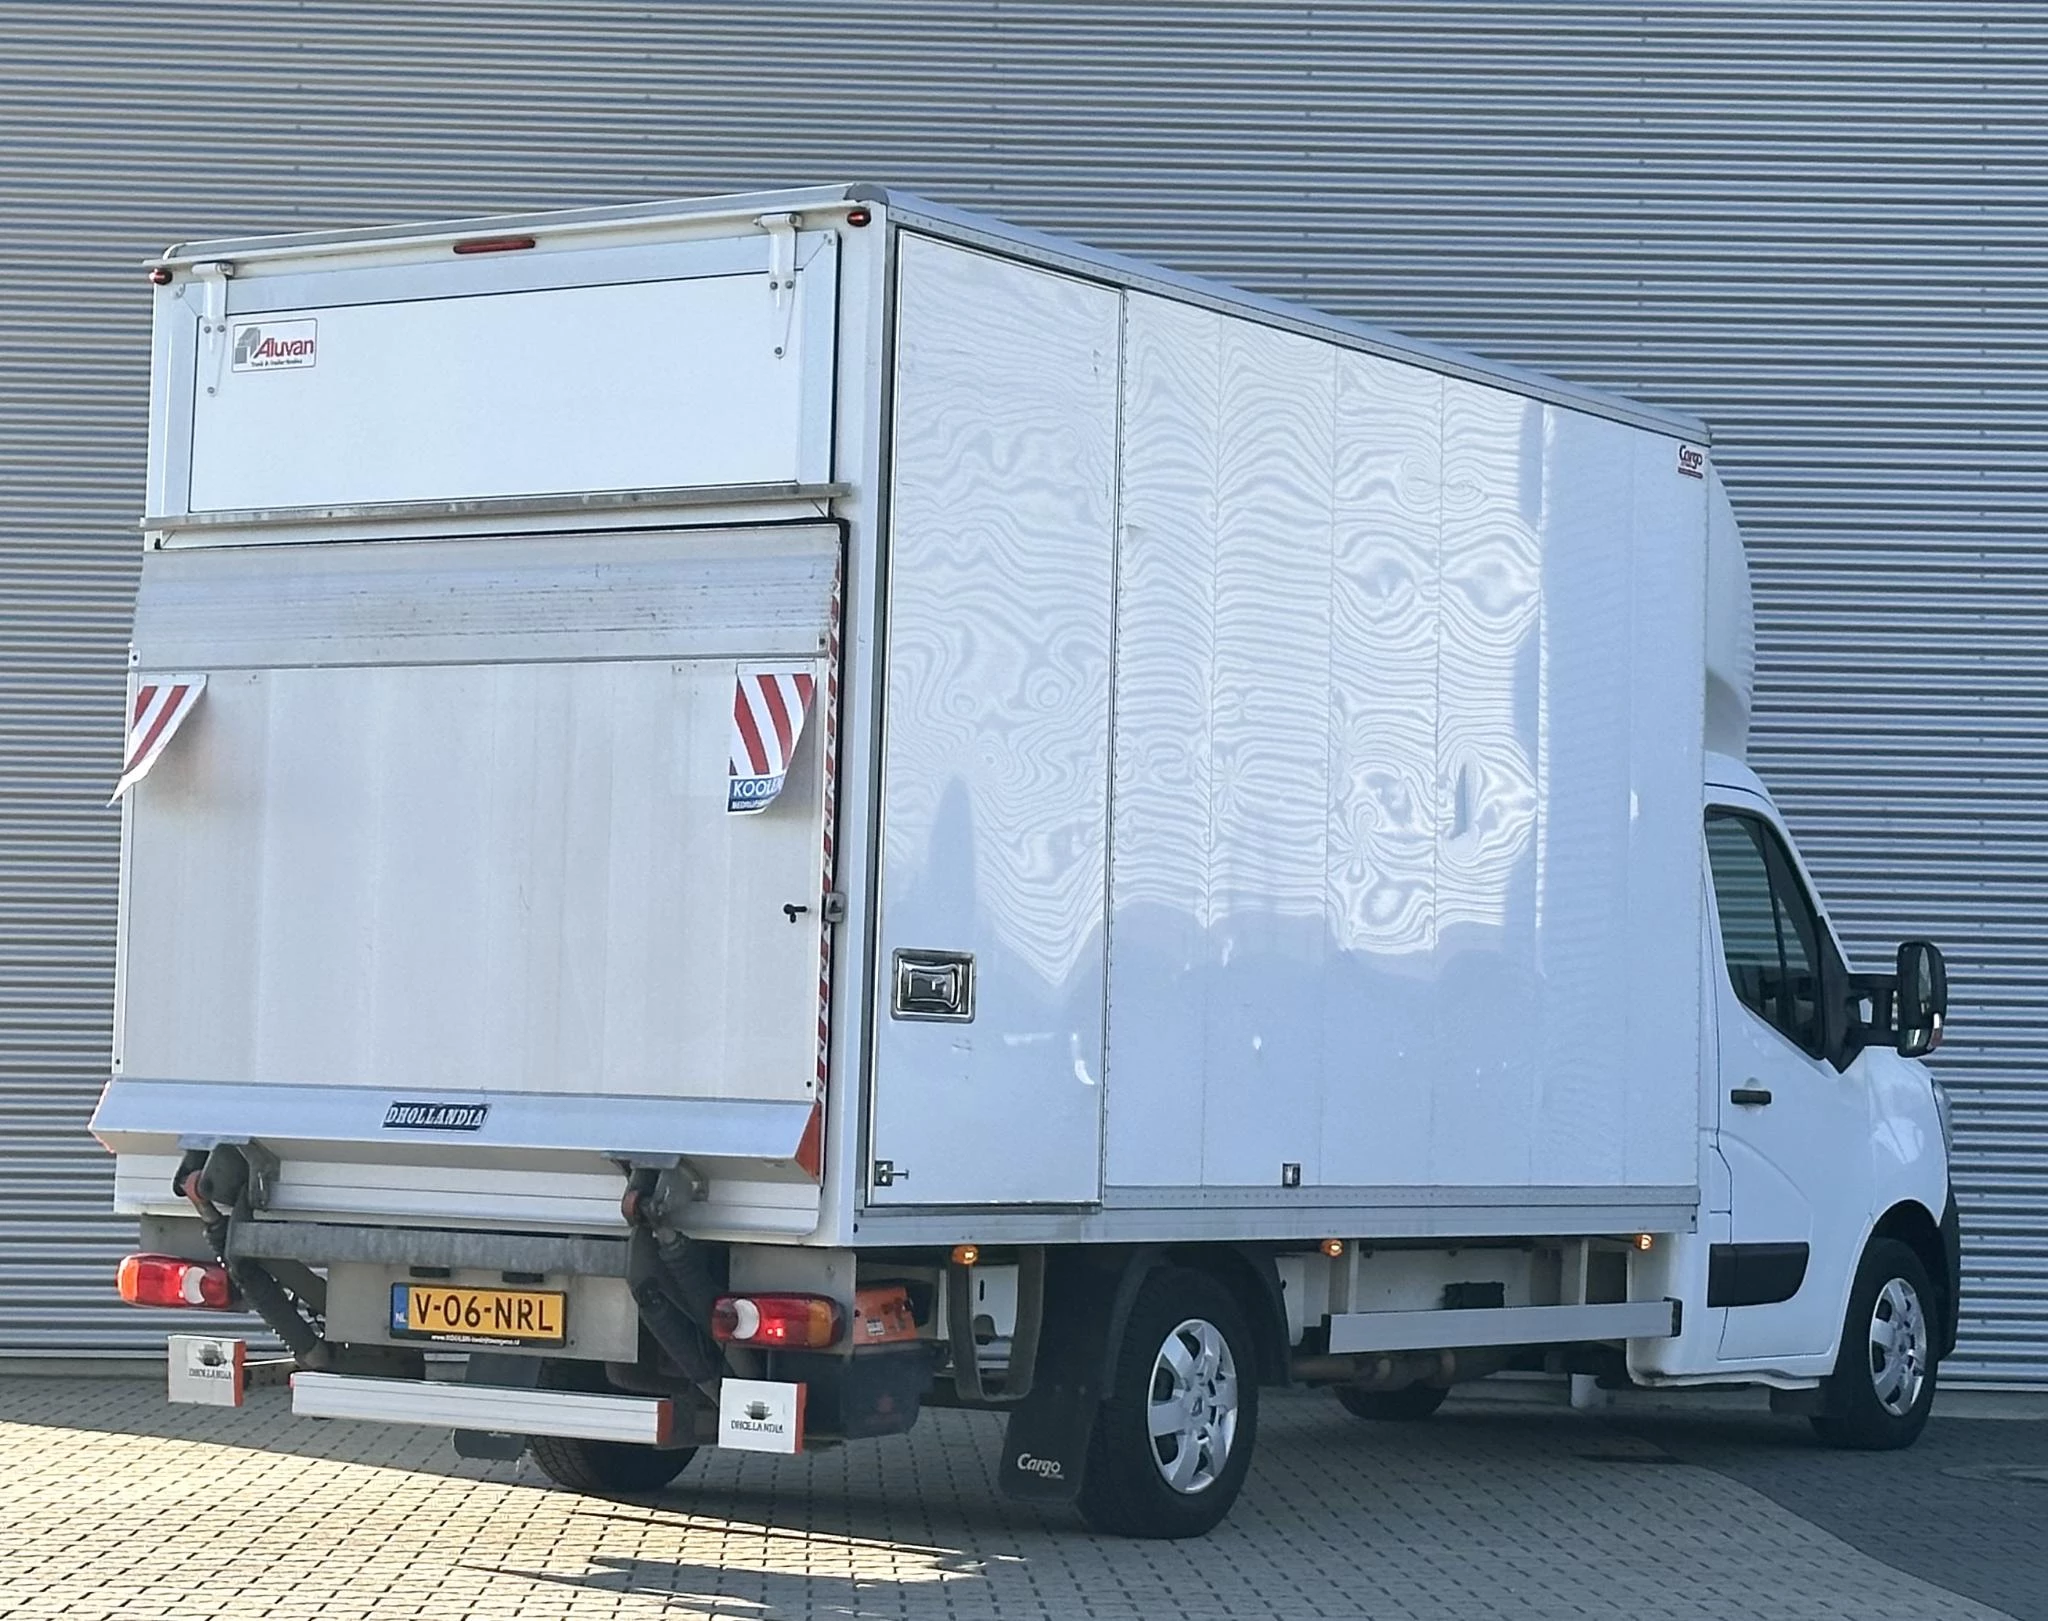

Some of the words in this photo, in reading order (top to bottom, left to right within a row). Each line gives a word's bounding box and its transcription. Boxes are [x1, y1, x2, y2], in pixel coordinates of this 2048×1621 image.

[253, 337, 314, 359] Aluvan
[1679, 444, 1703, 469] Cargo
[385, 1106, 484, 1126] DHOLLANDIA
[395, 1312, 407, 1323] NL
[415, 1293, 553, 1331] V-06-NRL
[1017, 1453, 1061, 1477] Cargo
